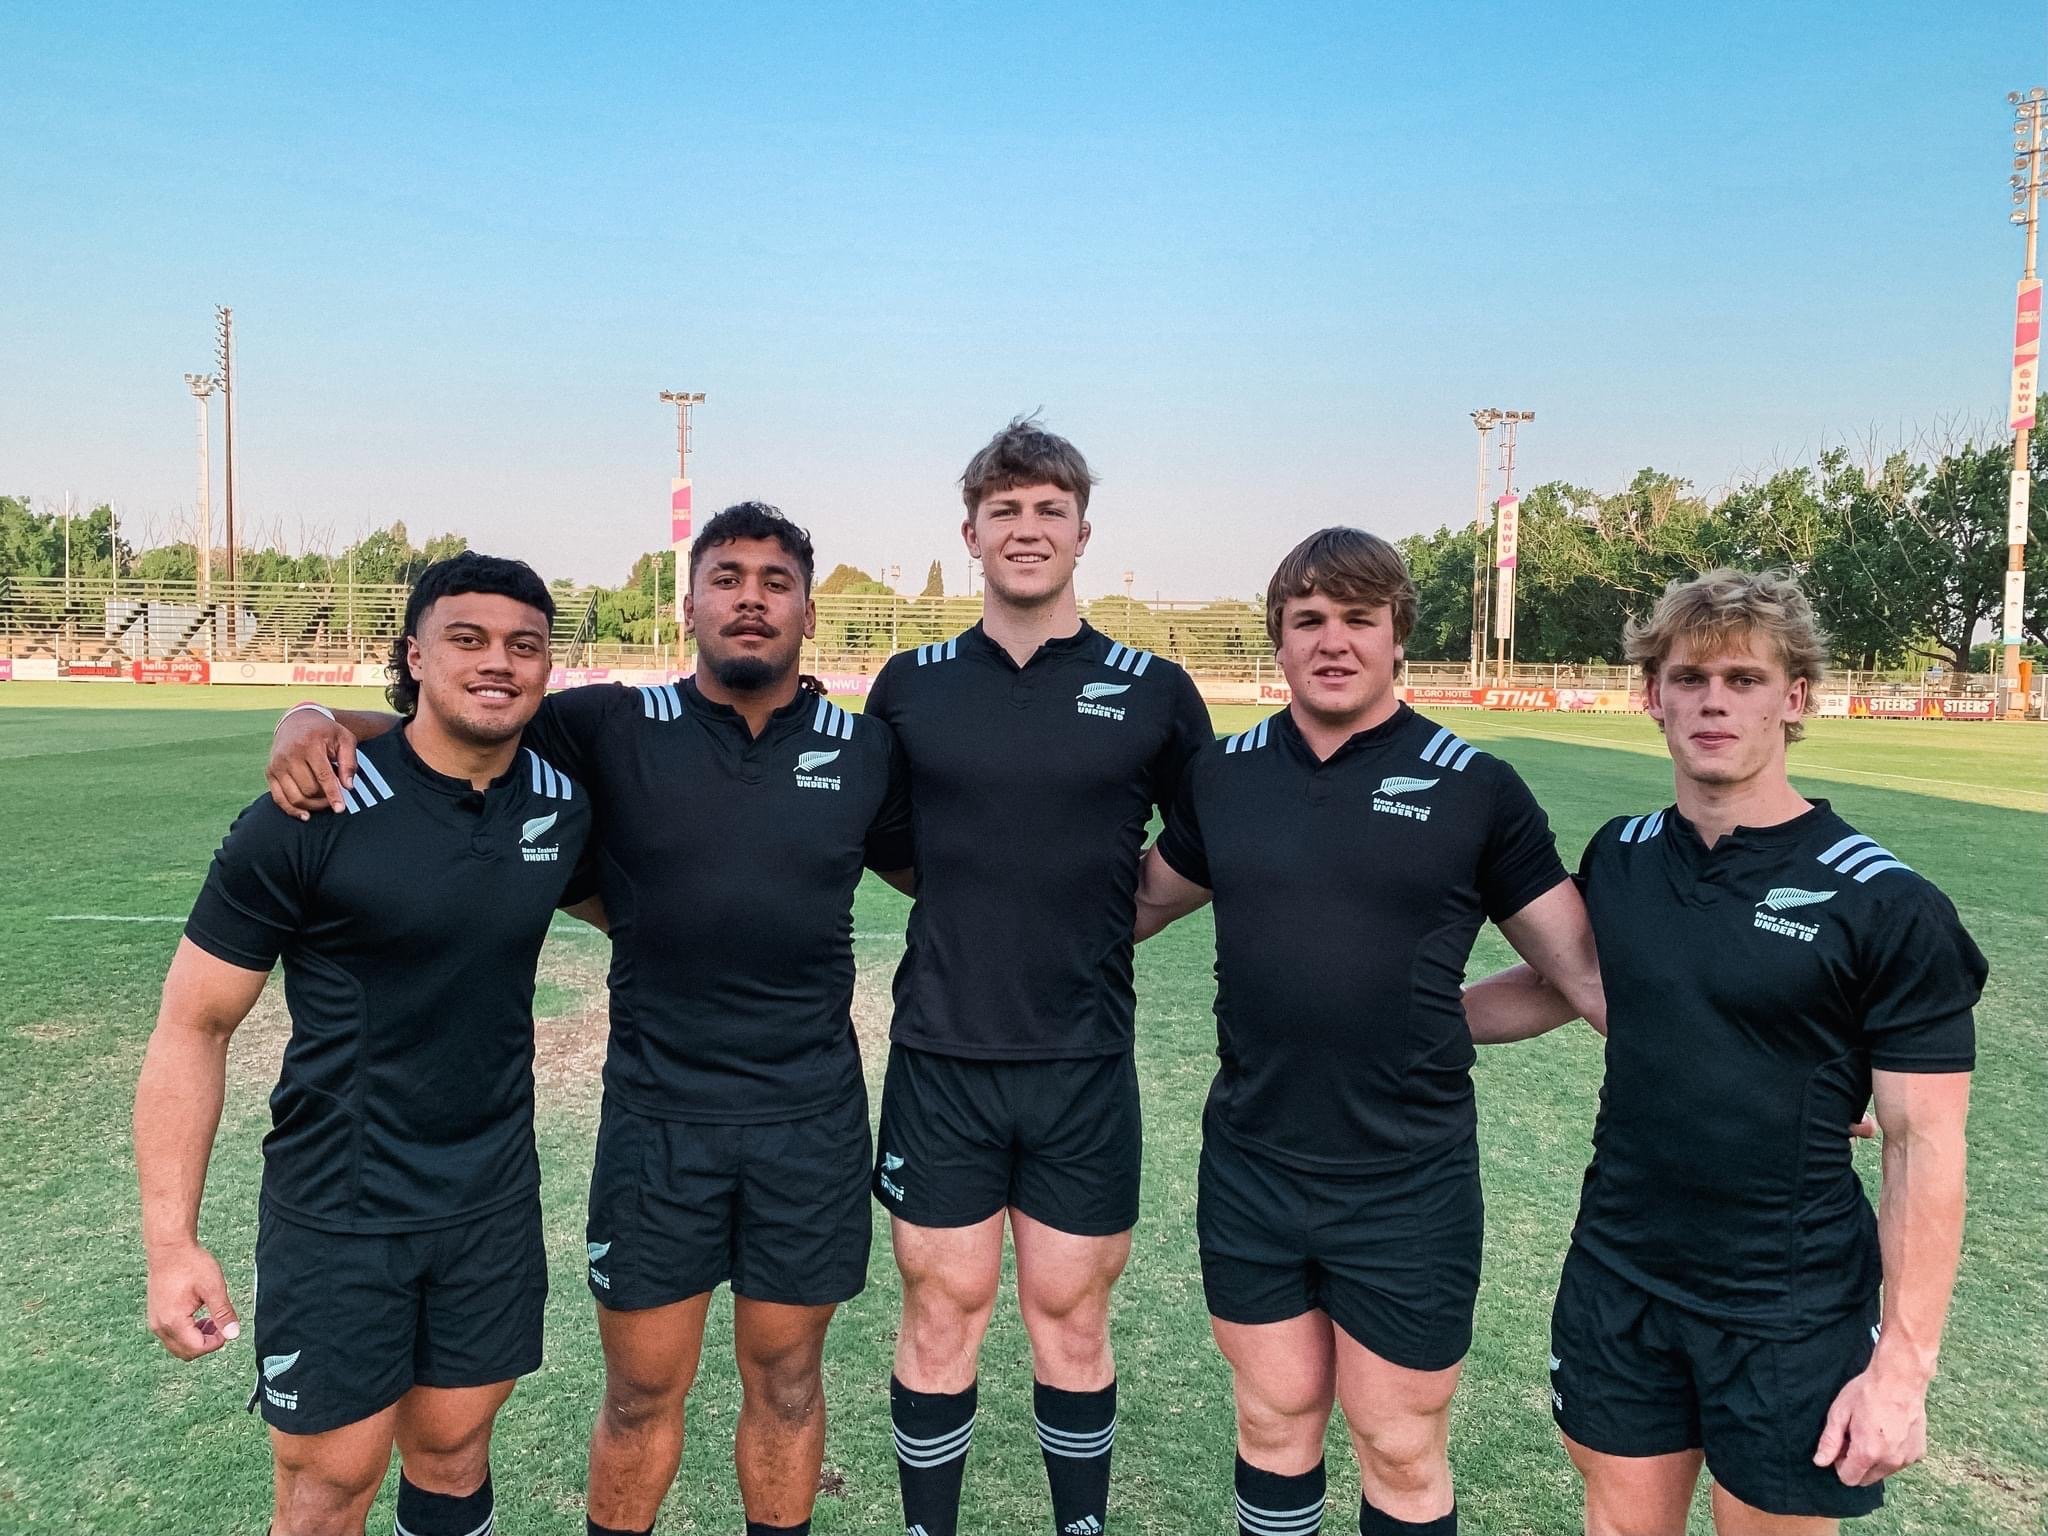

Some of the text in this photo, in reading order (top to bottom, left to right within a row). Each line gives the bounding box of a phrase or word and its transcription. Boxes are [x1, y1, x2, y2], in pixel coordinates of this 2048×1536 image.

[2018, 382, 2031, 414] NWU
[1502, 523, 1513, 553] NWU
[293, 665, 355, 682] Herald
[832, 680, 860, 690] NWU
[1414, 689, 1473, 698] ELGRO HOTEL
[1483, 689, 1552, 707] STIHL
[1096, 704, 1126, 715] Zealand
[1869, 698, 1917, 712] STEERS
[1943, 700, 1991, 714] STEERS
[1078, 707, 1124, 721] UNDER 19
[797, 780, 841, 791] UNDER 19
[814, 776, 841, 784] Zealand
[1373, 798, 1431, 815] New Zealand
[1373, 804, 1428, 821] UNDER 19
[523, 853, 550, 862] UNDER
[1755, 911, 1819, 934] New Zealand
[1753, 918, 1814, 942] UNDER 19
[287, 1400, 297, 1410] 19
